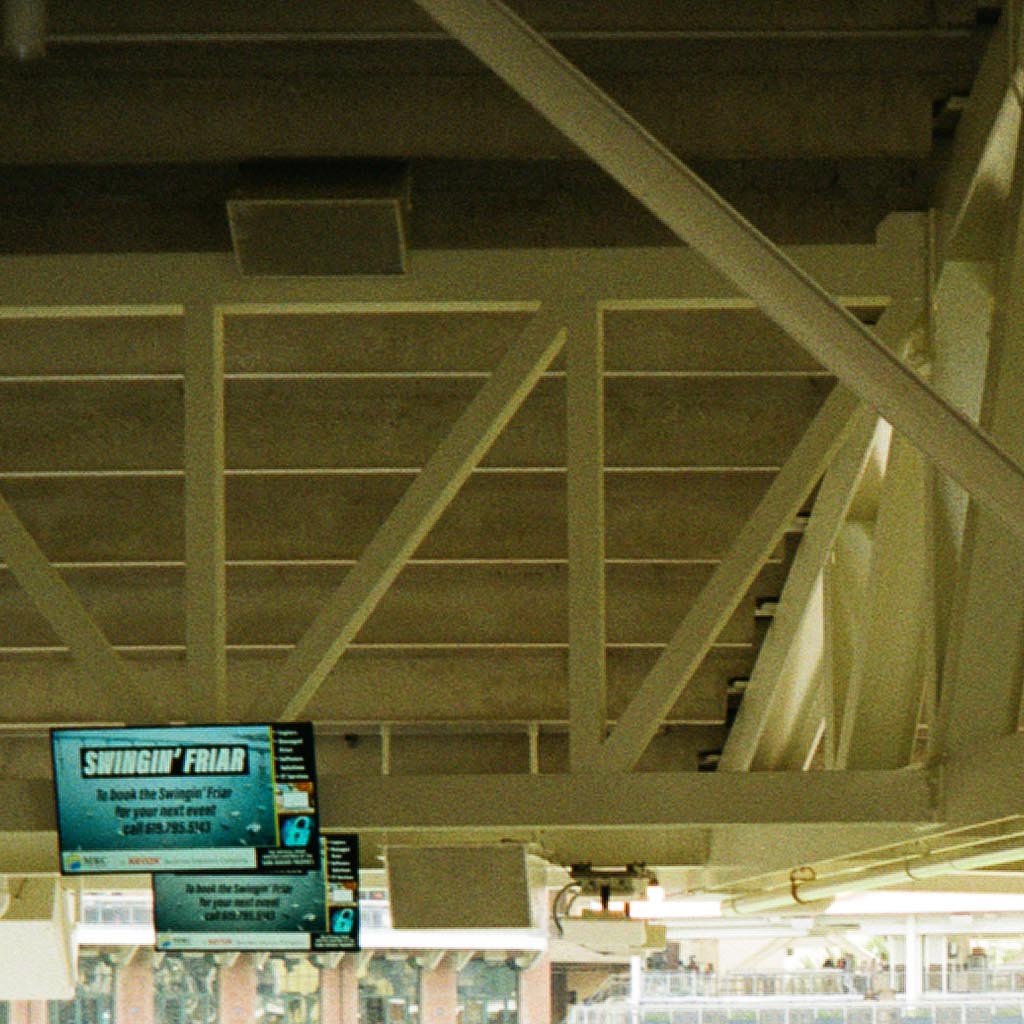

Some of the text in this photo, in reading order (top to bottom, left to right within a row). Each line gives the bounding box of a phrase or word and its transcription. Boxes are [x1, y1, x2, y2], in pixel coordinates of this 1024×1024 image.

[83, 748, 182, 775] SWINGIN'
[183, 747, 246, 772] FRIAR
[110, 788, 136, 800] book
[139, 788, 156, 800] the
[206, 786, 233, 799] Friar
[115, 805, 217, 820] for your next event
[123, 822, 142, 835] call
